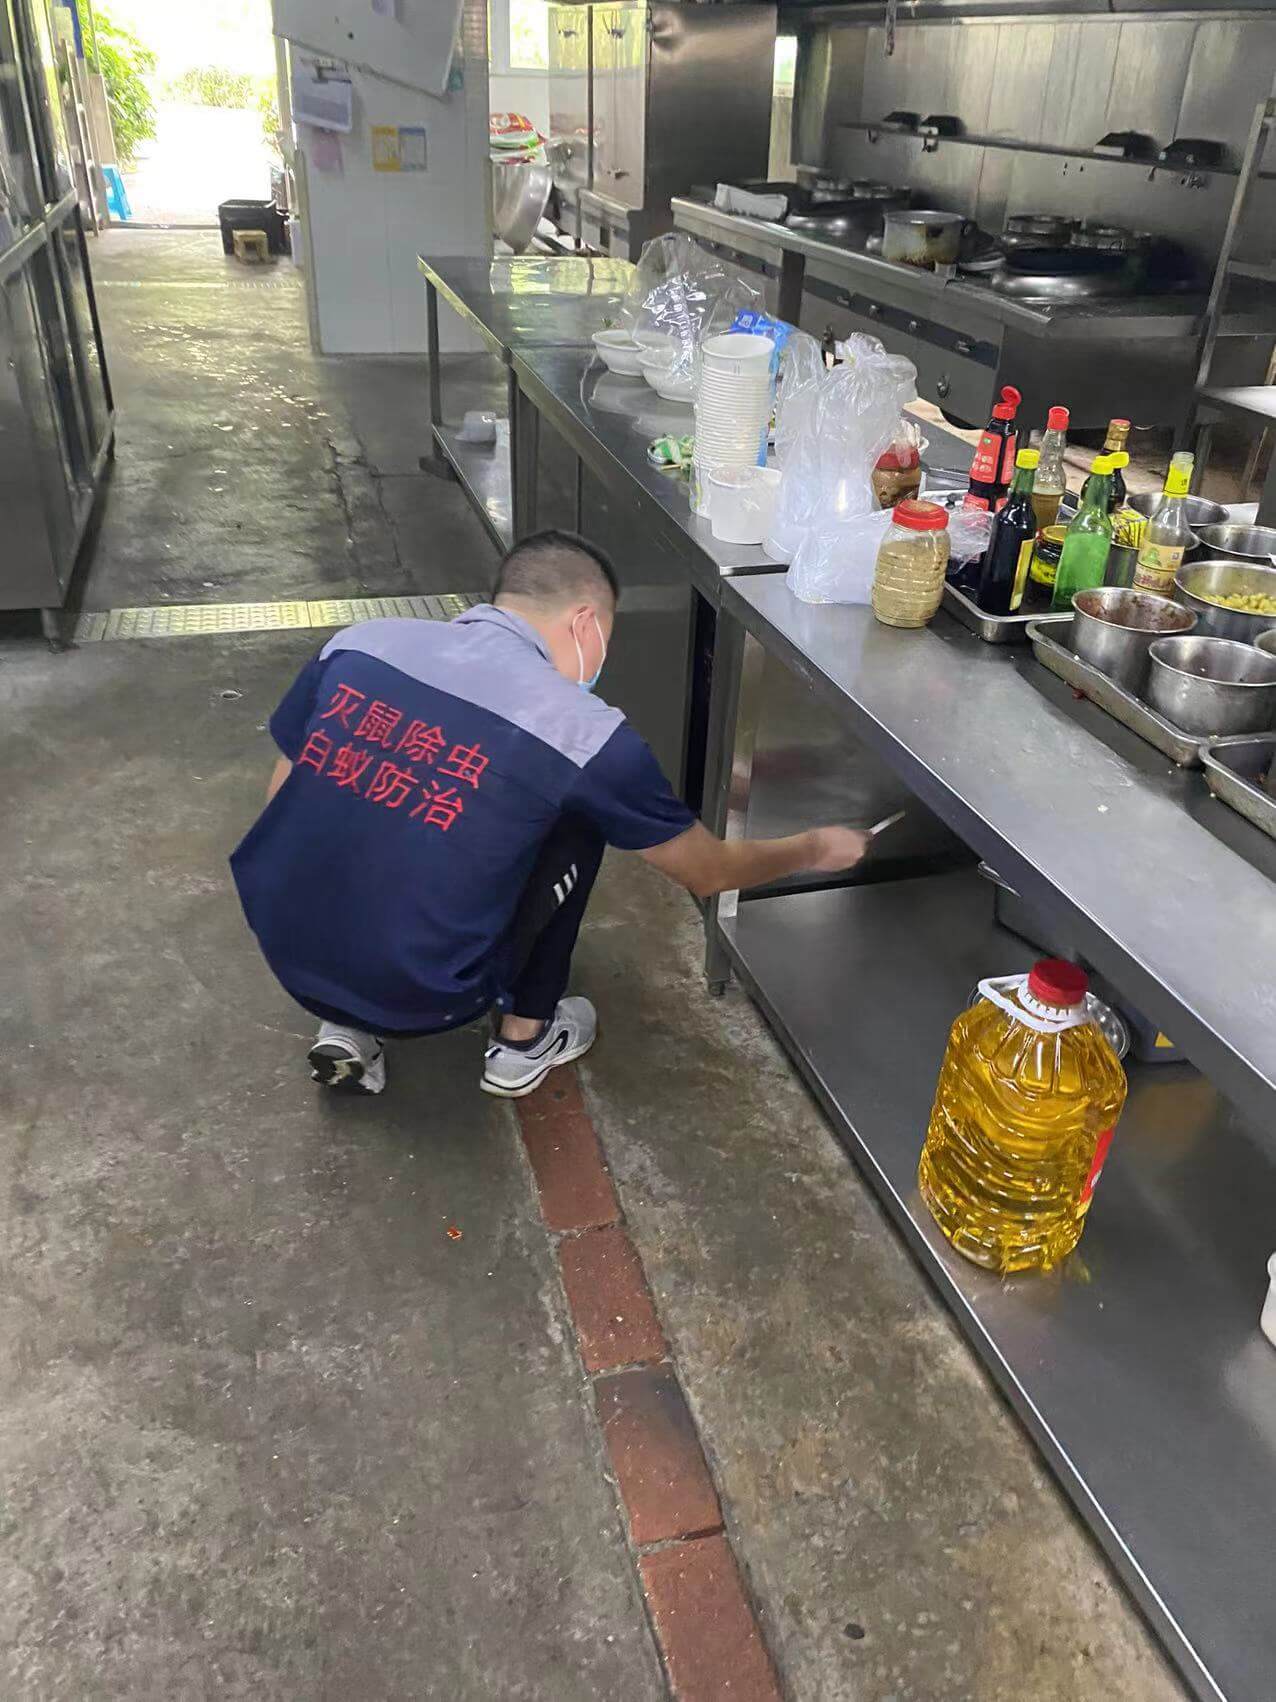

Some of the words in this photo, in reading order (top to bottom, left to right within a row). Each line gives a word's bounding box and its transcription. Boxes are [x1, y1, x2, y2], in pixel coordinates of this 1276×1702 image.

[296, 728, 463, 832] 白蚁防治
[319, 683, 490, 789] 灭鼠除虫
